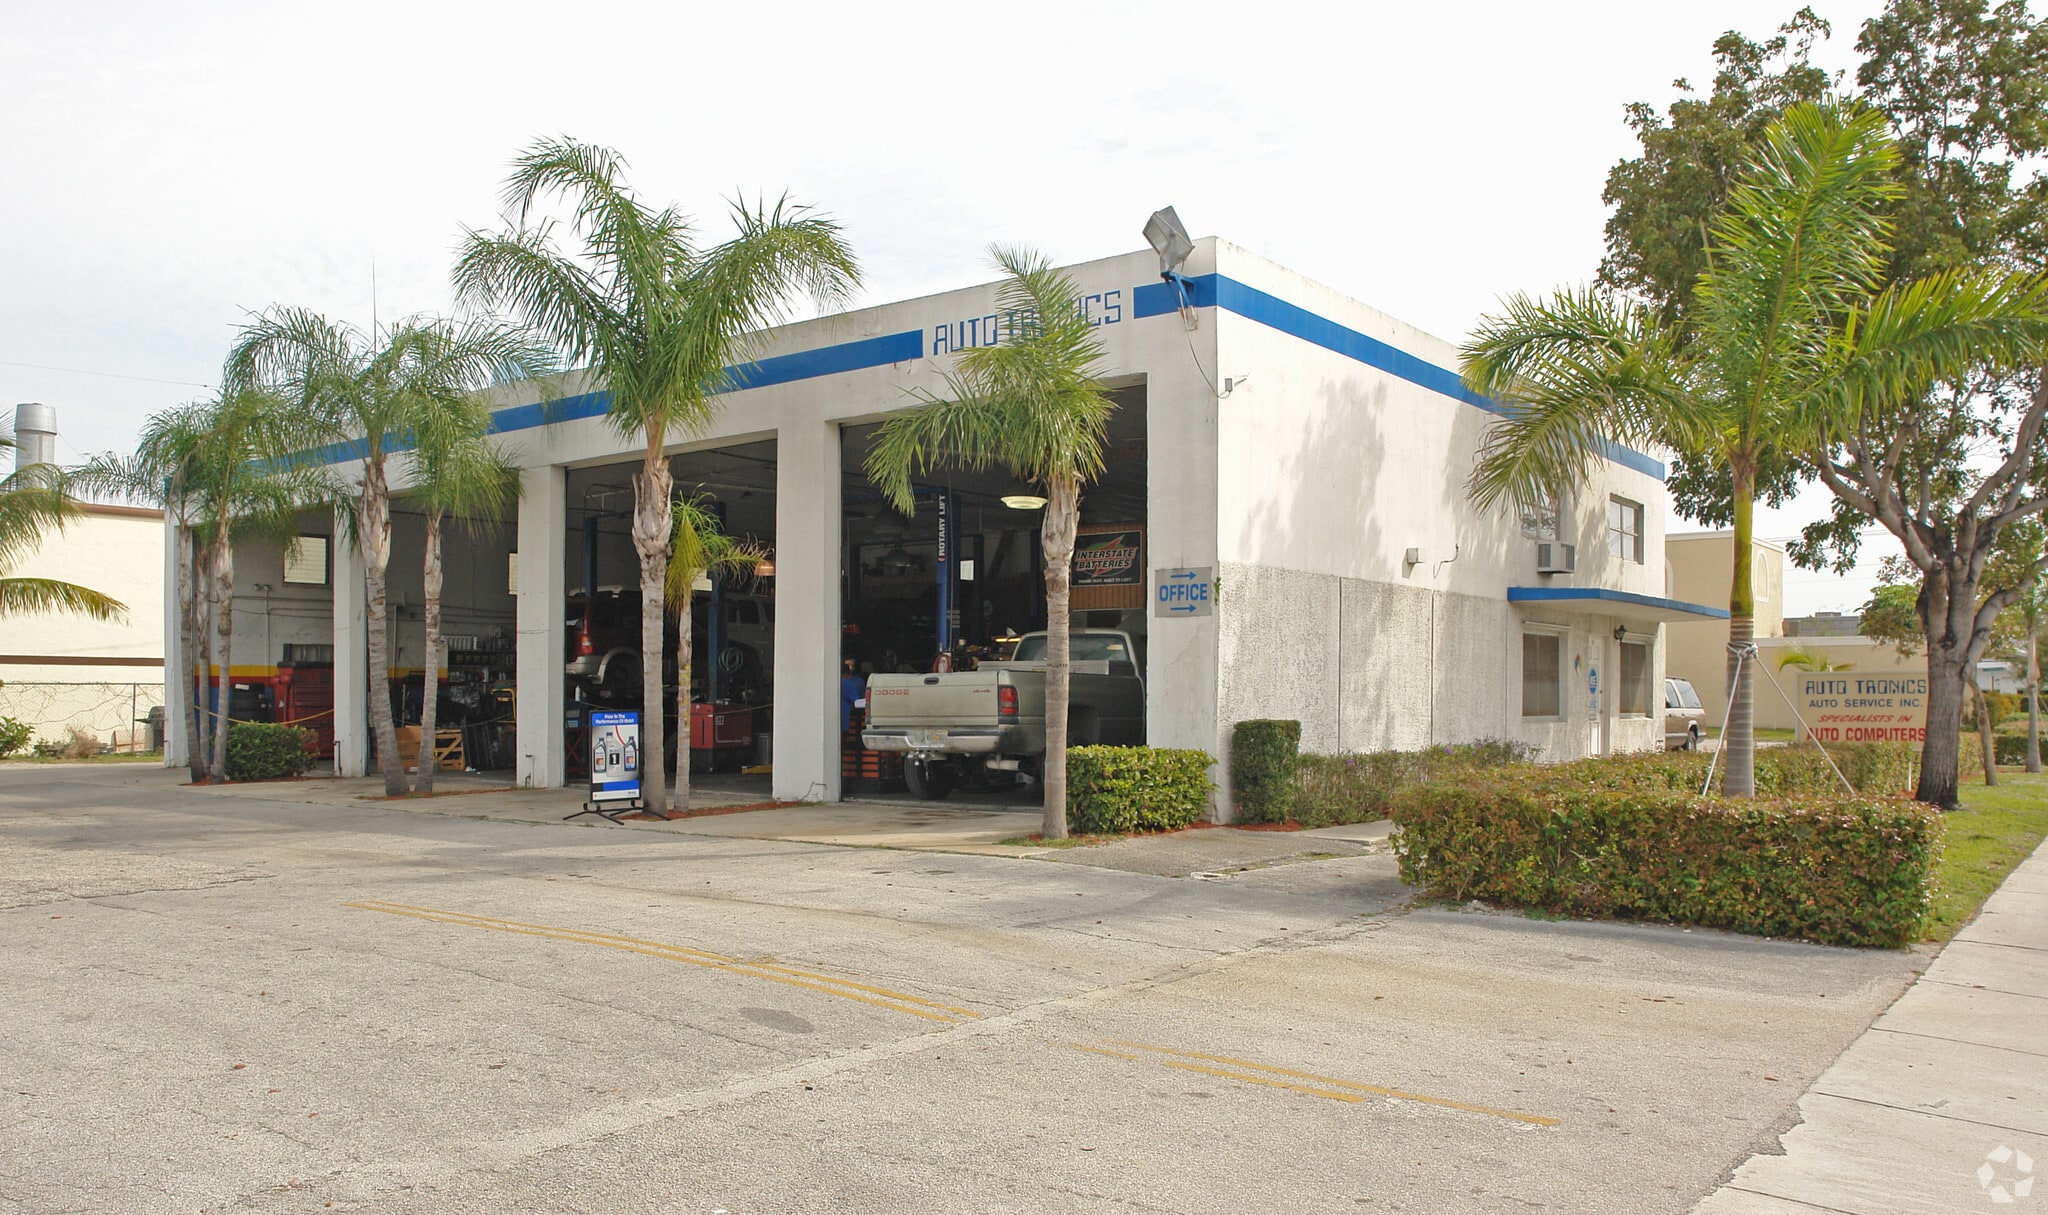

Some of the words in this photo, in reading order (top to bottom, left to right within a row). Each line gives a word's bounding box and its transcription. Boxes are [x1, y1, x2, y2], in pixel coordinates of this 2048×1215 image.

[934, 314, 998, 356] AUTO
[1004, 290, 1121, 341] TRICS
[1077, 548, 1134, 559] INTERSTATE
[1078, 559, 1130, 569] BATTERIES
[1159, 583, 1208, 602] OFFICE
[1805, 680, 1847, 695] AUTO
[1855, 679, 1927, 695] TRONICS
[1809, 699, 1838, 708] AUTO
[1844, 698, 1893, 708] SERVICE
[1900, 698, 1924, 708] INC.
[1817, 714, 1895, 723] SPECIALISTS
[1897, 714, 1914, 722] IN
[1806, 727, 1839, 742] AUTO
[1845, 727, 1927, 742] COMPUTERS
[611, 754, 617, 764] 1
